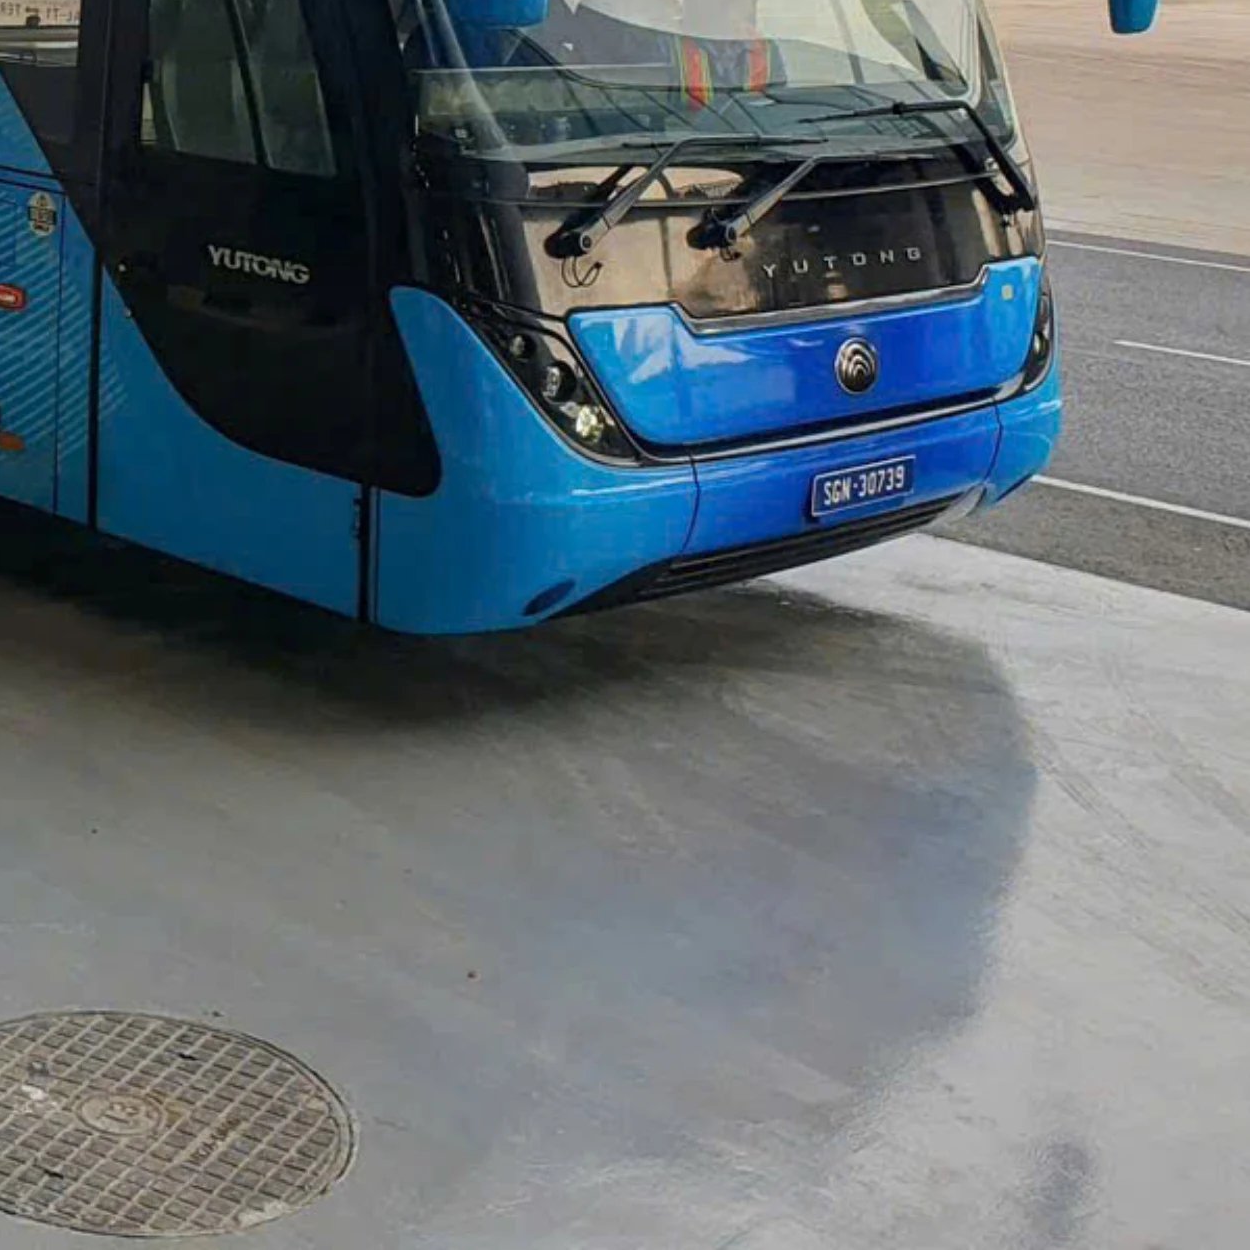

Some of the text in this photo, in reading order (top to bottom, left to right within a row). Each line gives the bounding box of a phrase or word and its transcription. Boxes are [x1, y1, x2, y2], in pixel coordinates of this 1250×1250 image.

[206, 244, 311, 285] YUTONG
[763, 246, 923, 279] YUTONG
[823, 464, 906, 507] SGN-30739
